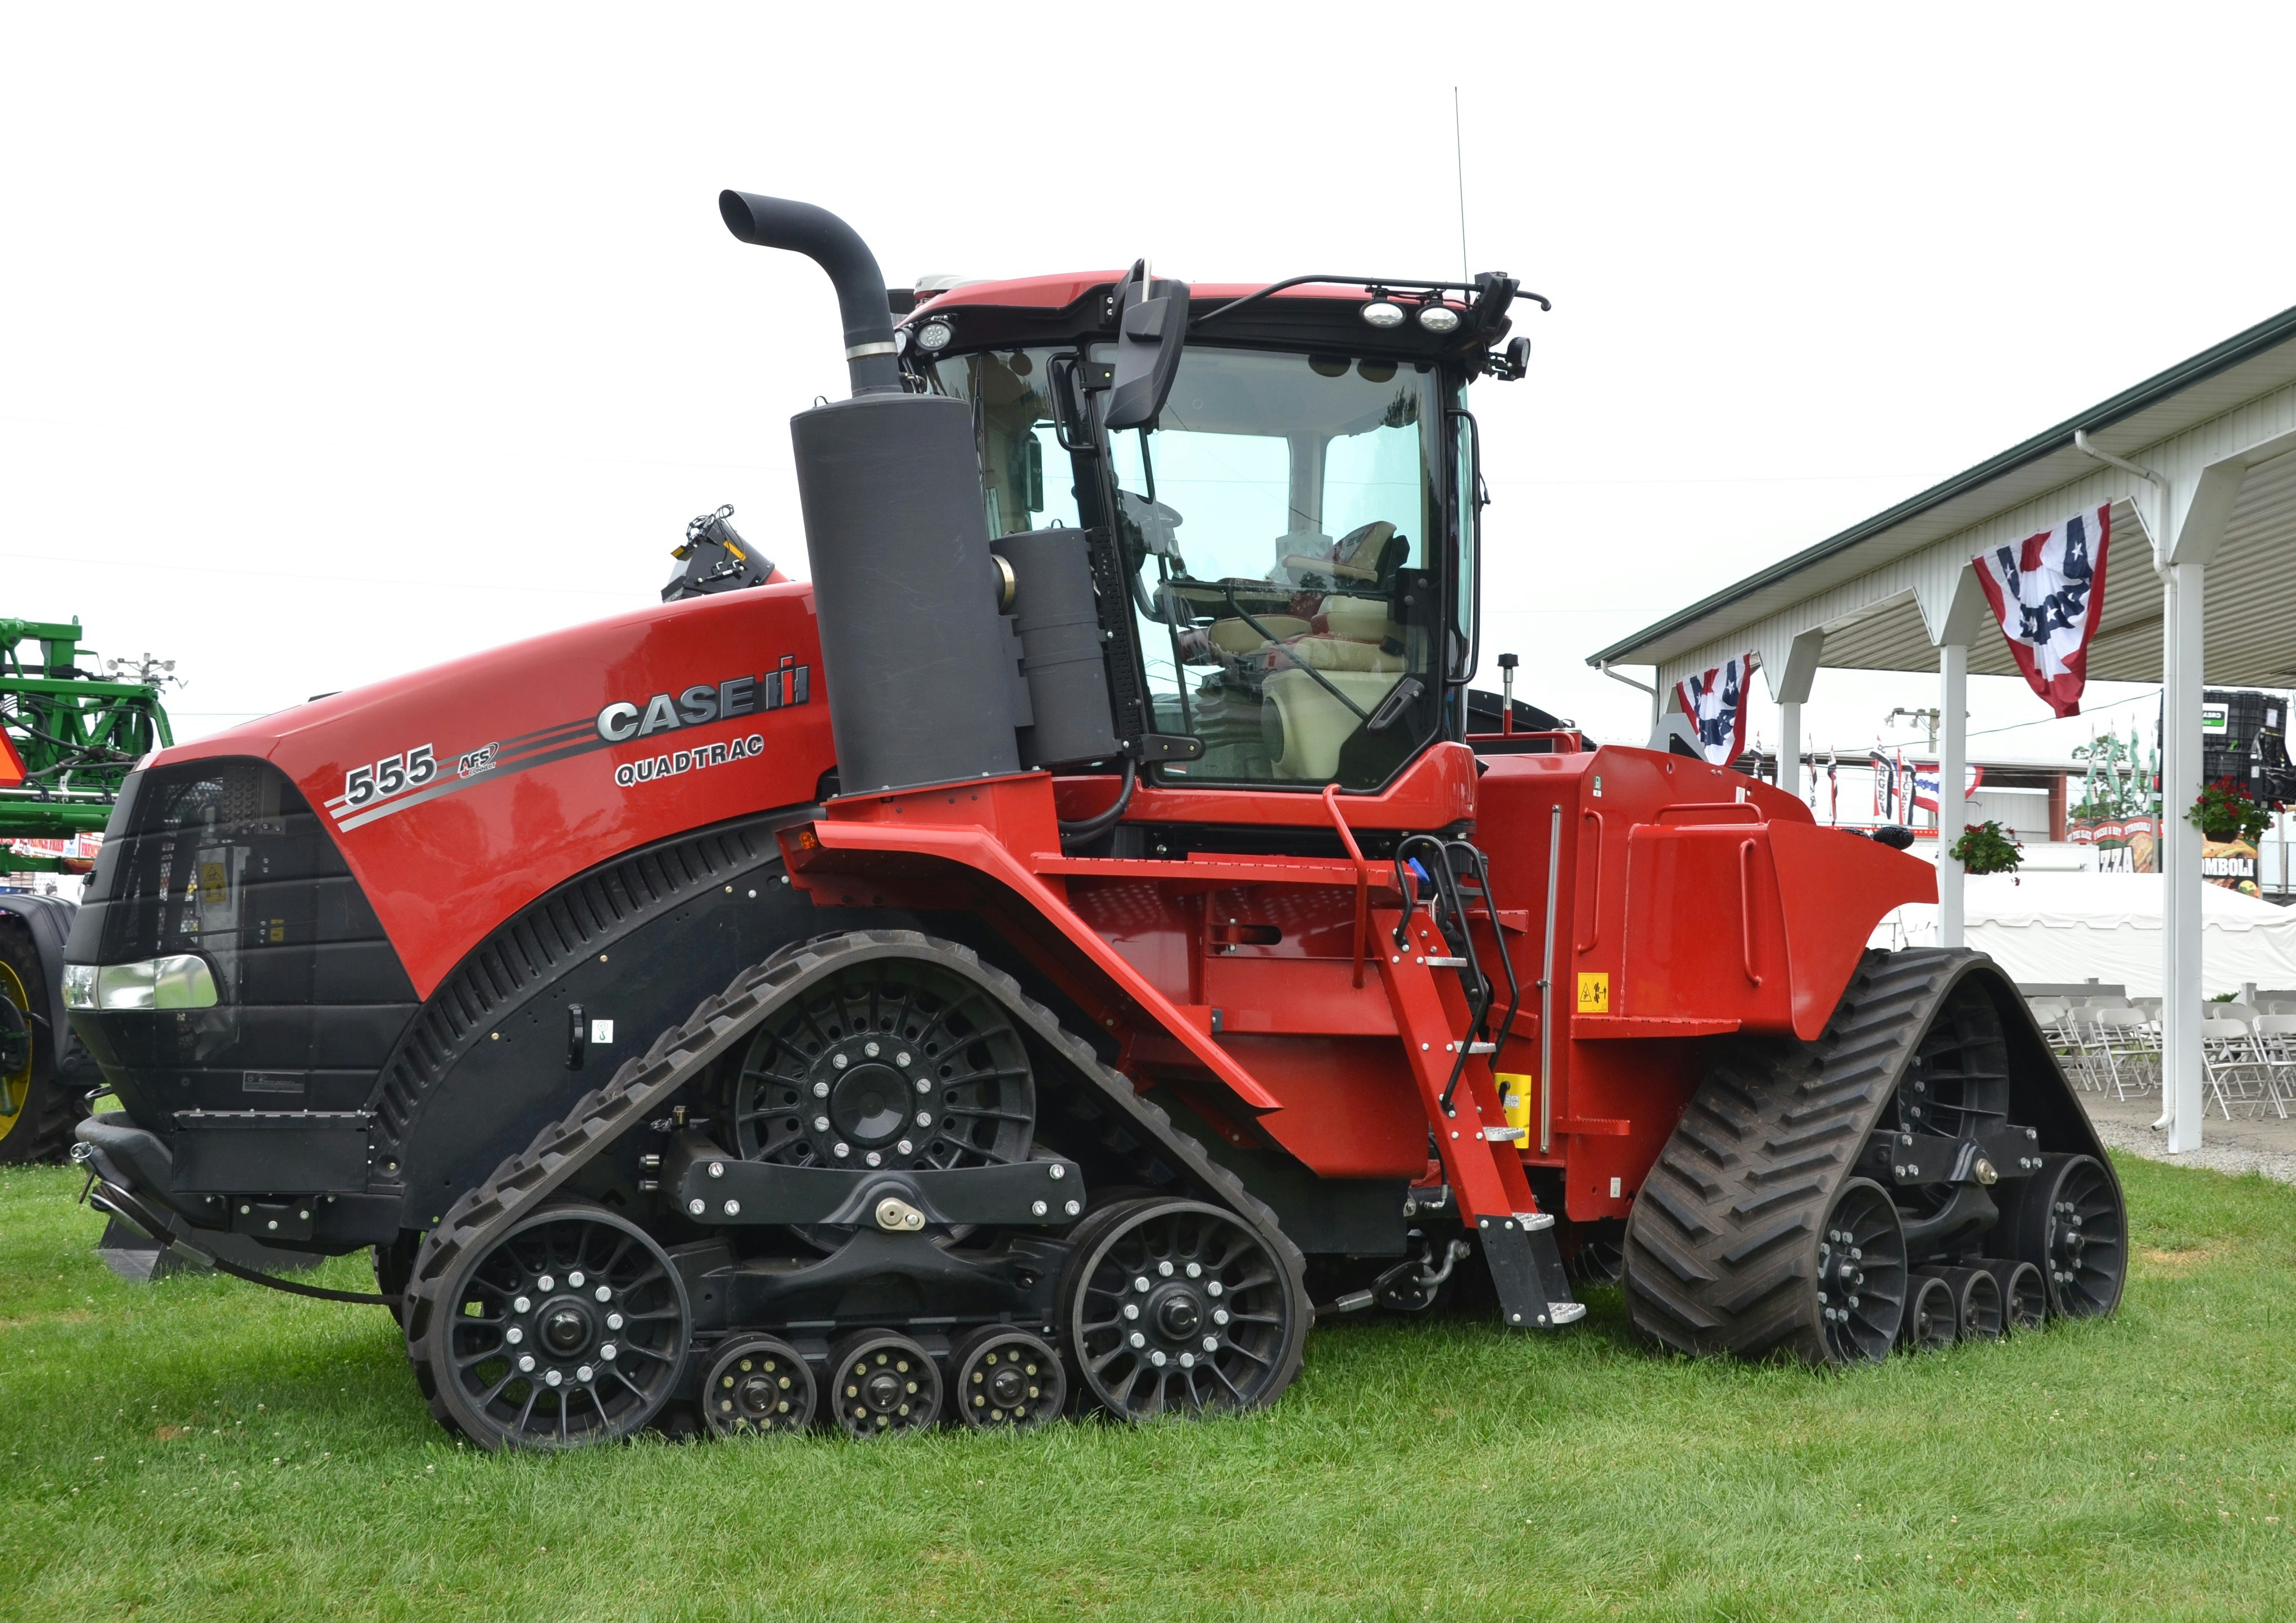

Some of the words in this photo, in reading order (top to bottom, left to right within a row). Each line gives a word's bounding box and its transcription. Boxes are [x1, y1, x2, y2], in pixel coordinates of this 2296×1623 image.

[597, 676, 755, 741] CASE
[345, 744, 437, 807] 555
[458, 747, 490, 773] AFS
[469, 761, 496, 776] CONNECT
[615, 734, 763, 787] QUADTRAC
